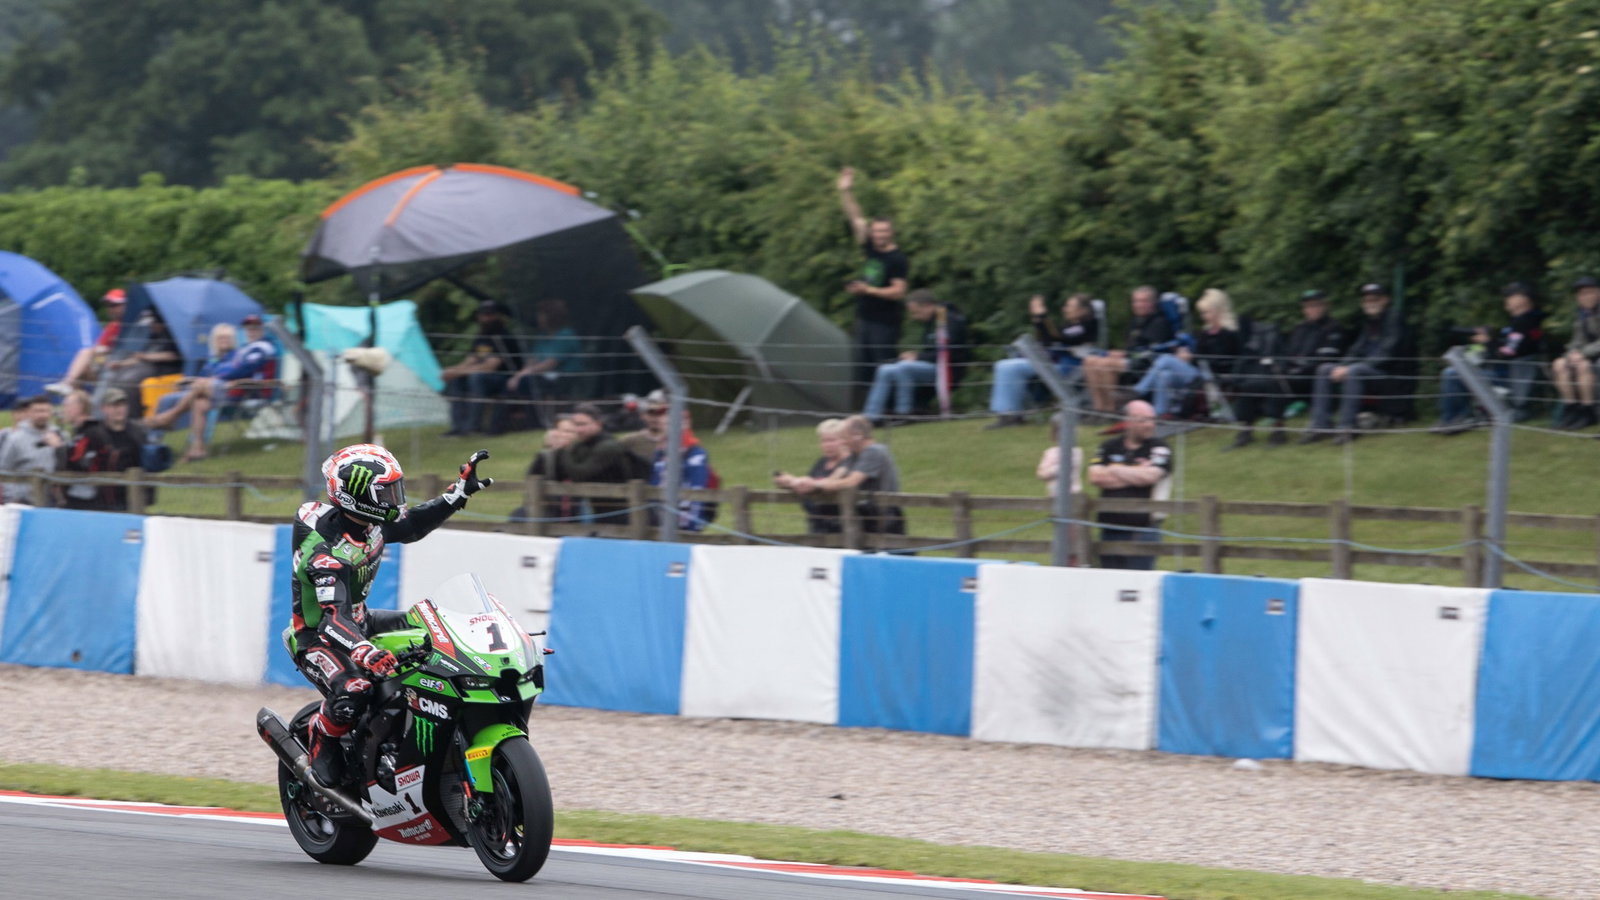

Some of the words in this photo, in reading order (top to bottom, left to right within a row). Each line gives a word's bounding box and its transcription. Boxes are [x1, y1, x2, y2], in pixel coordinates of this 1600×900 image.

[486, 622, 508, 652] 1
[419, 678, 436, 688] elf
[418, 697, 448, 719] CMS
[398, 770, 421, 786] SHOWA
[371, 801, 406, 818] Kawasaki
[404, 792, 422, 815] 1
